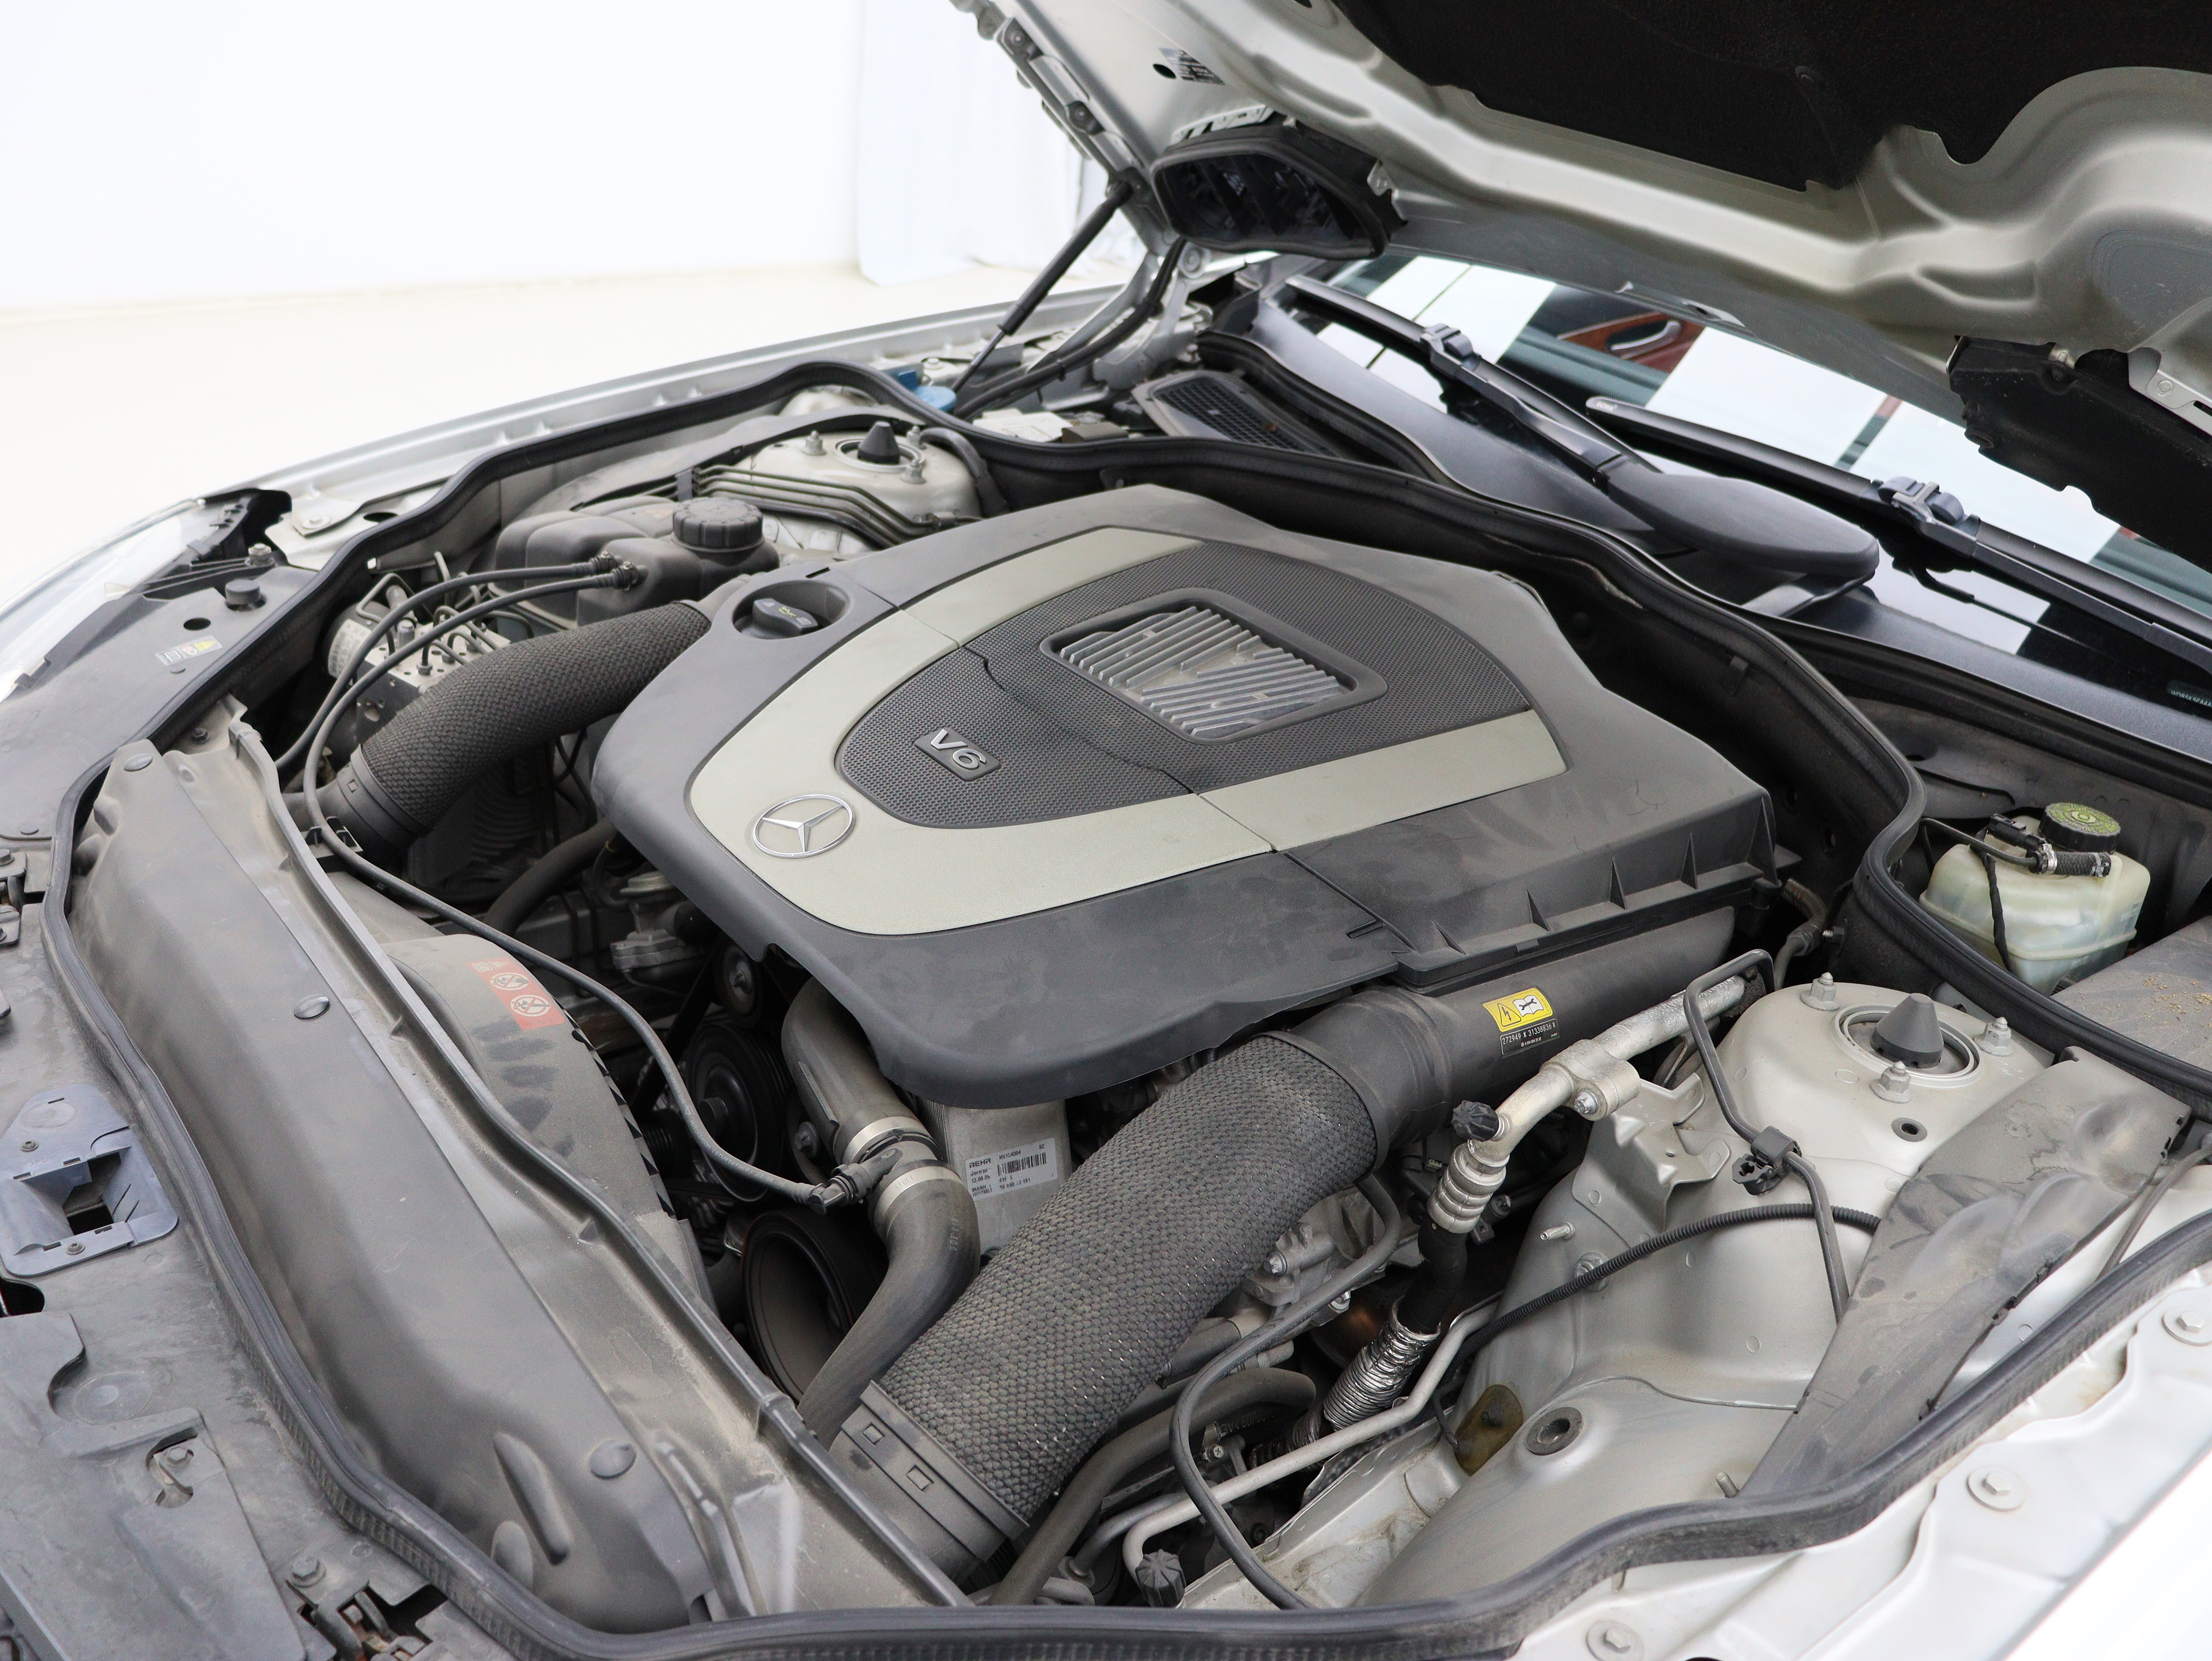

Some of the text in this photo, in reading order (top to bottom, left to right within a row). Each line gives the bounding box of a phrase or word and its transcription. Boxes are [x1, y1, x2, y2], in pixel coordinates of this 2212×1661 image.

[931, 729, 986, 769] V6
[1502, 1033, 1521, 1044] 272949
[1528, 1023, 1552, 1037] 31338836
[690, 1120, 711, 1149] HUTCHINSON
[969, 1158, 991, 1169] BEHR
